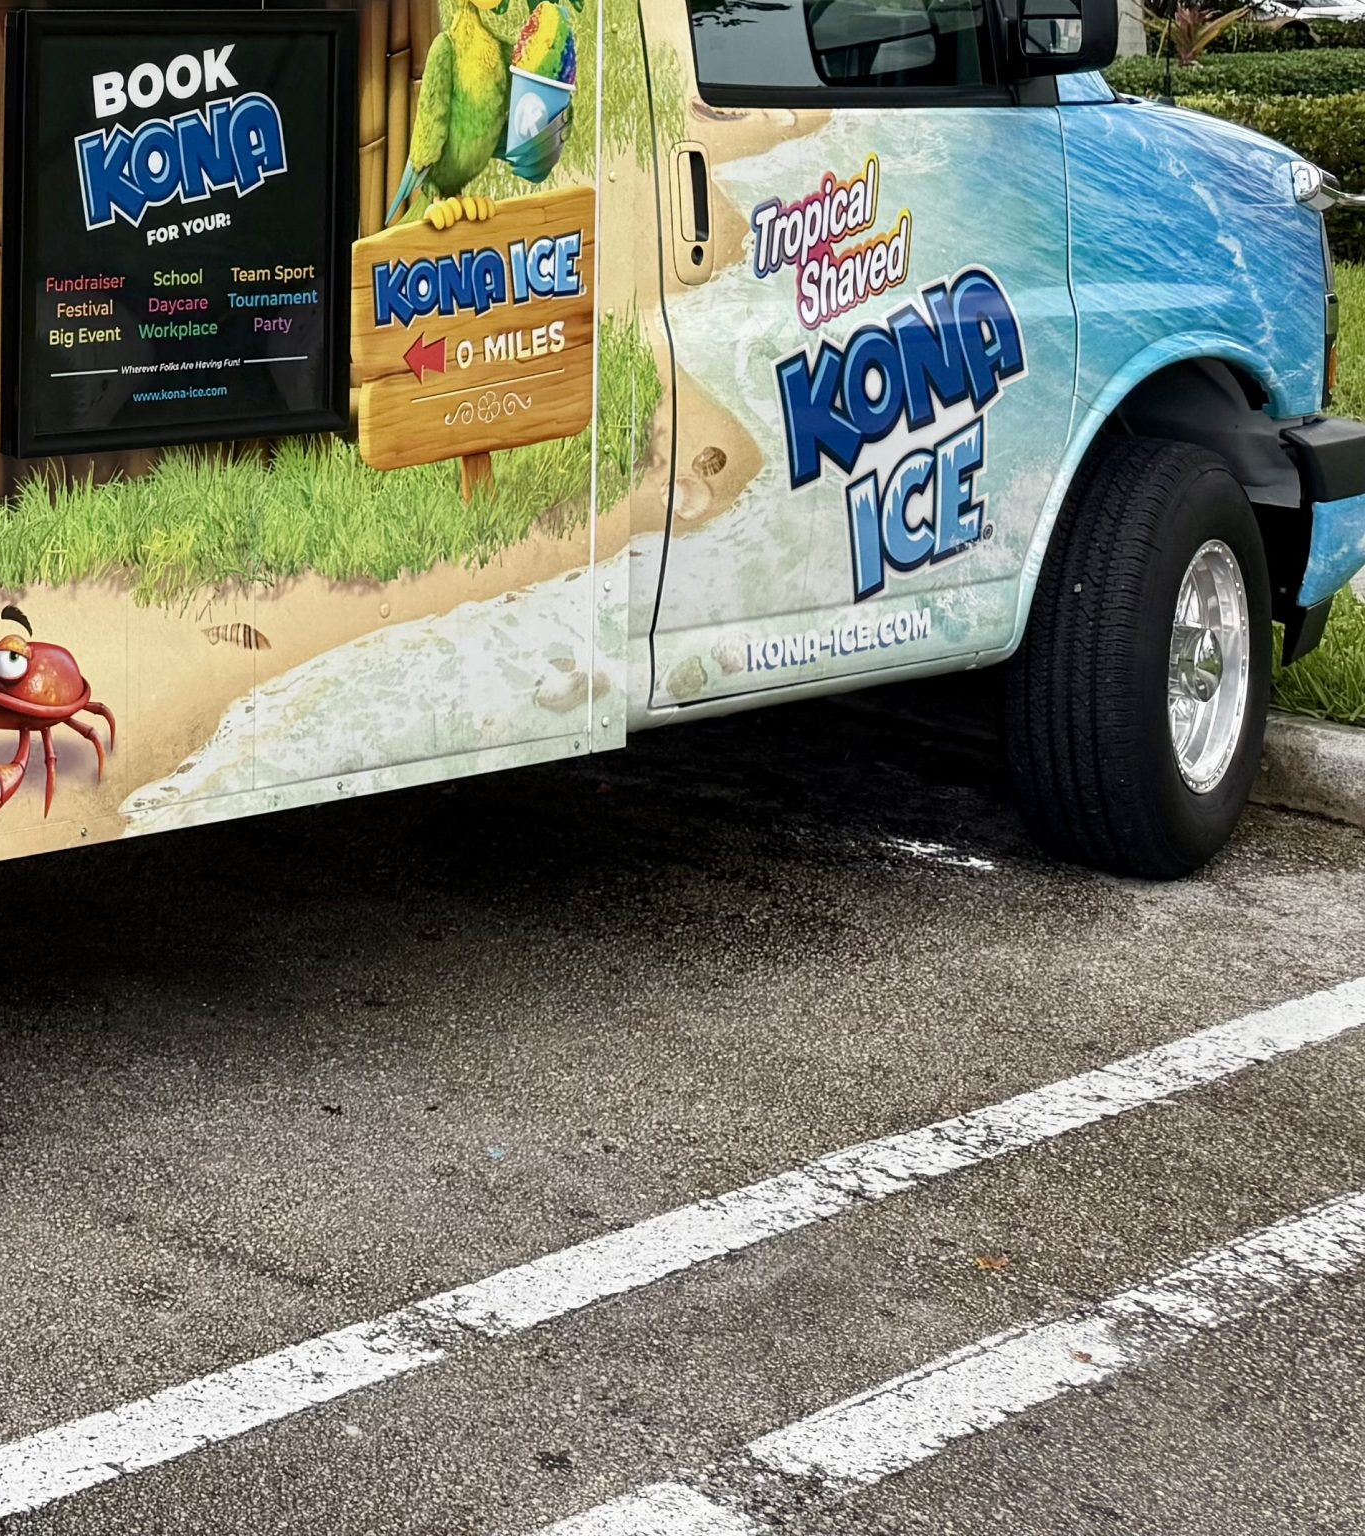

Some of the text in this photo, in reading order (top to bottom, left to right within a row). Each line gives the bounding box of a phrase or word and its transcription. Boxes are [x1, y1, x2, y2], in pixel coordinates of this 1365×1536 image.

[92, 43, 239, 119] BOOK
[75, 92, 287, 230] KONA
[754, 157, 878, 277] Tropical
[147, 213, 232, 246] FOR YOUR:
[153, 269, 203, 287] School
[231, 265, 315, 284] Team Sport
[374, 231, 584, 328] KONA ICE
[799, 213, 909, 328] Shaved
[46, 274, 126, 292] Fundraiser
[57, 300, 113, 318] Festival
[148, 296, 209, 315] Daycare
[228, 289, 318, 308] Tournament
[49, 326, 122, 348] Big Event
[138, 320, 218, 341] Workplace
[254, 317, 292, 335] Party
[456, 320, 566, 369] 0 MILES
[121, 358, 241, 375] Wherever Folks Are Having Fun!
[774, 266, 1026, 492] KONA
[133, 385, 228, 403] www.kona-ice.com
[845, 415, 985, 605] ICE
[747, 607, 932, 673] KONA-ICE.COM
